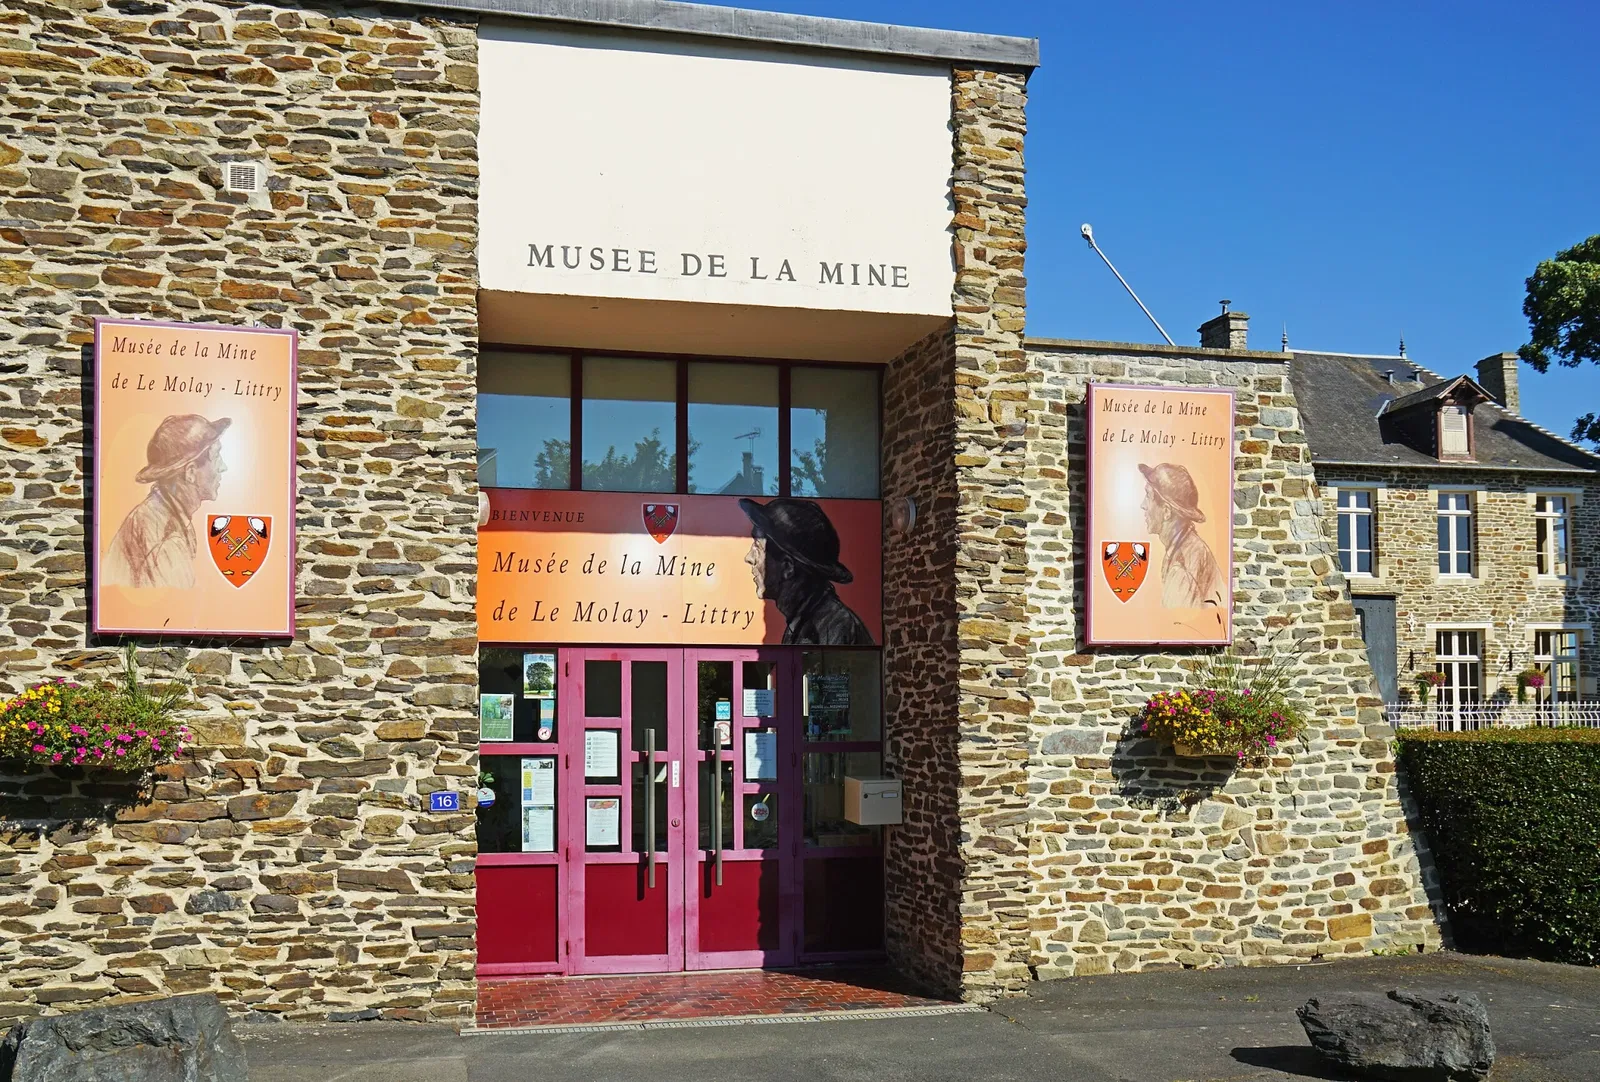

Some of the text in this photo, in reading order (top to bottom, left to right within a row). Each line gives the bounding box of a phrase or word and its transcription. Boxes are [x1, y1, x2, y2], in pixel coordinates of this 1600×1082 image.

[526, 243, 910, 288] MUSEE DE LA MINE
[112, 336, 257, 361] Musée de la Mine
[111, 372, 129, 390] de
[136, 374, 156, 391] Le
[163, 375, 213, 398] Molay
[234, 379, 282, 402] Littry
[1102, 398, 1208, 416] Musée de la Mine
[1102, 428, 1115, 442] de
[1120, 429, 1135, 443] Le
[1140, 429, 1176, 447] Molay
[1191, 431, 1226, 449] Littry
[491, 509, 586, 524] BIENVENUE
[492, 551, 716, 577] Musée de la Mine
[492, 600, 518, 623] de
[531, 601, 560, 623] Le
[572, 602, 649, 629] Molay
[681, 605, 755, 631] Littry
[437, 795, 452, 808] 16
